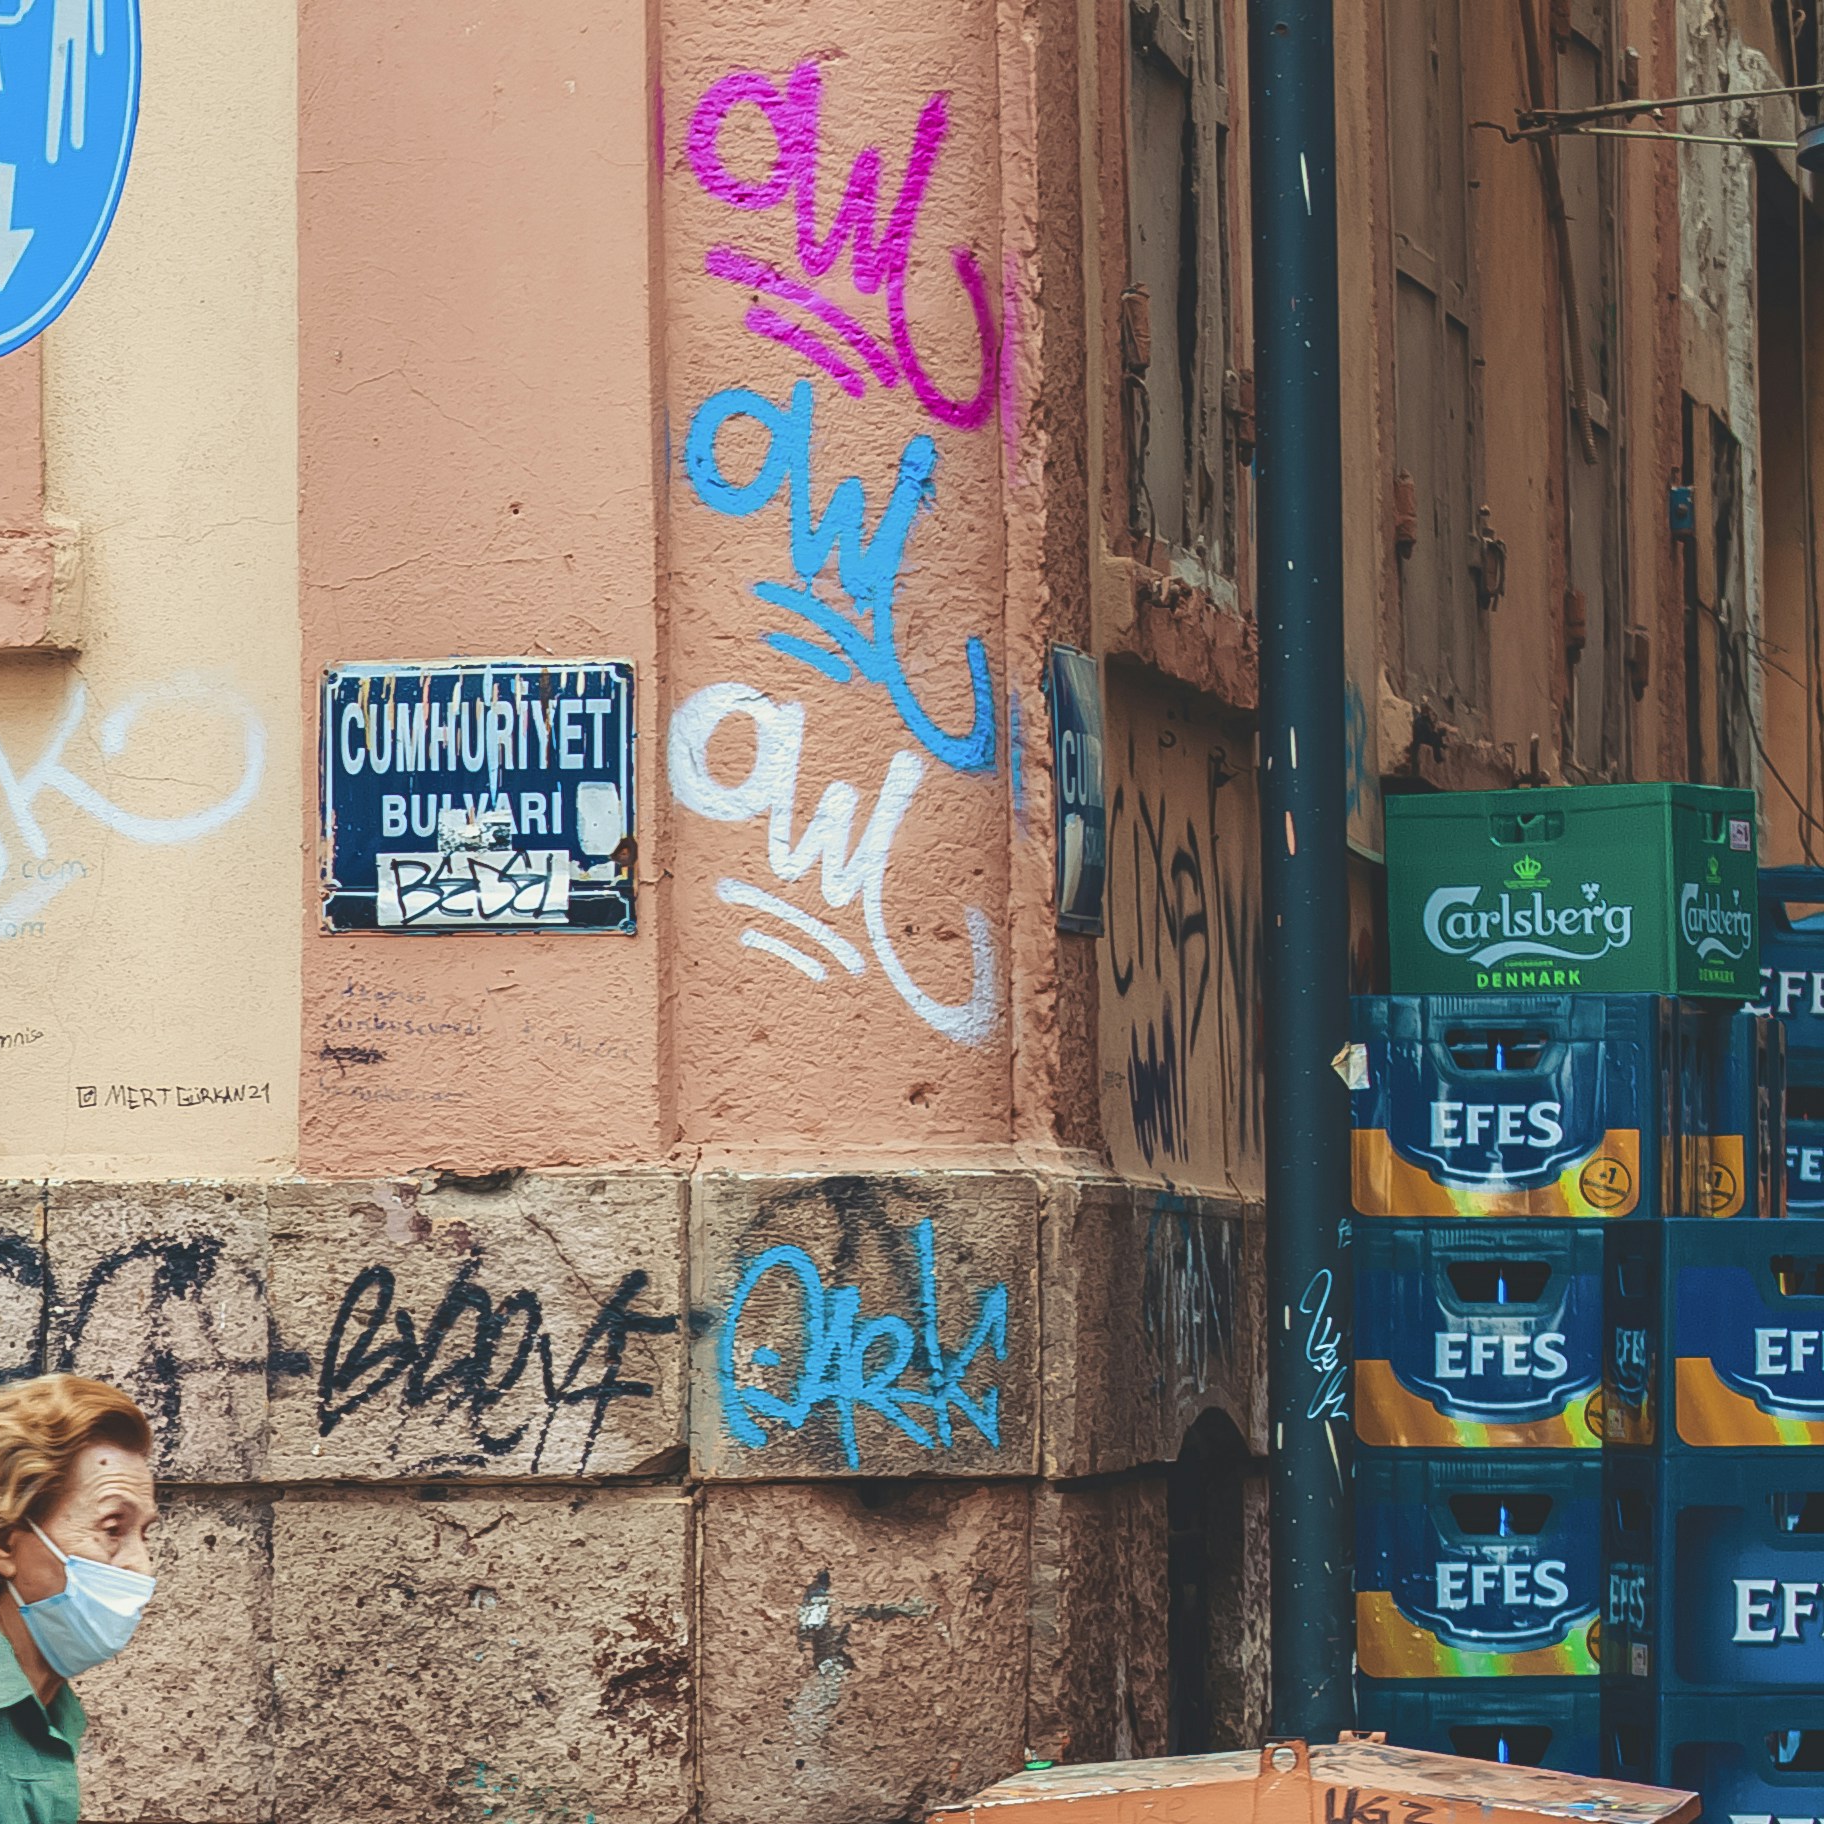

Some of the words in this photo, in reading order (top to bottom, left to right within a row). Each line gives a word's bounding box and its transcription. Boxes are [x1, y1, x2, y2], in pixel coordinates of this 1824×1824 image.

[340, 684, 612, 775] CUMHURİYET
[1423, 882, 1633, 967] Carlsberg
[1680, 882, 1752, 959] Carlsberg
[1476, 969, 1582, 989] DENMARK
[1429, 1101, 1564, 1149] EFES
[1434, 1331, 1569, 1380] EFES
[1435, 1559, 1569, 1609] EFES
